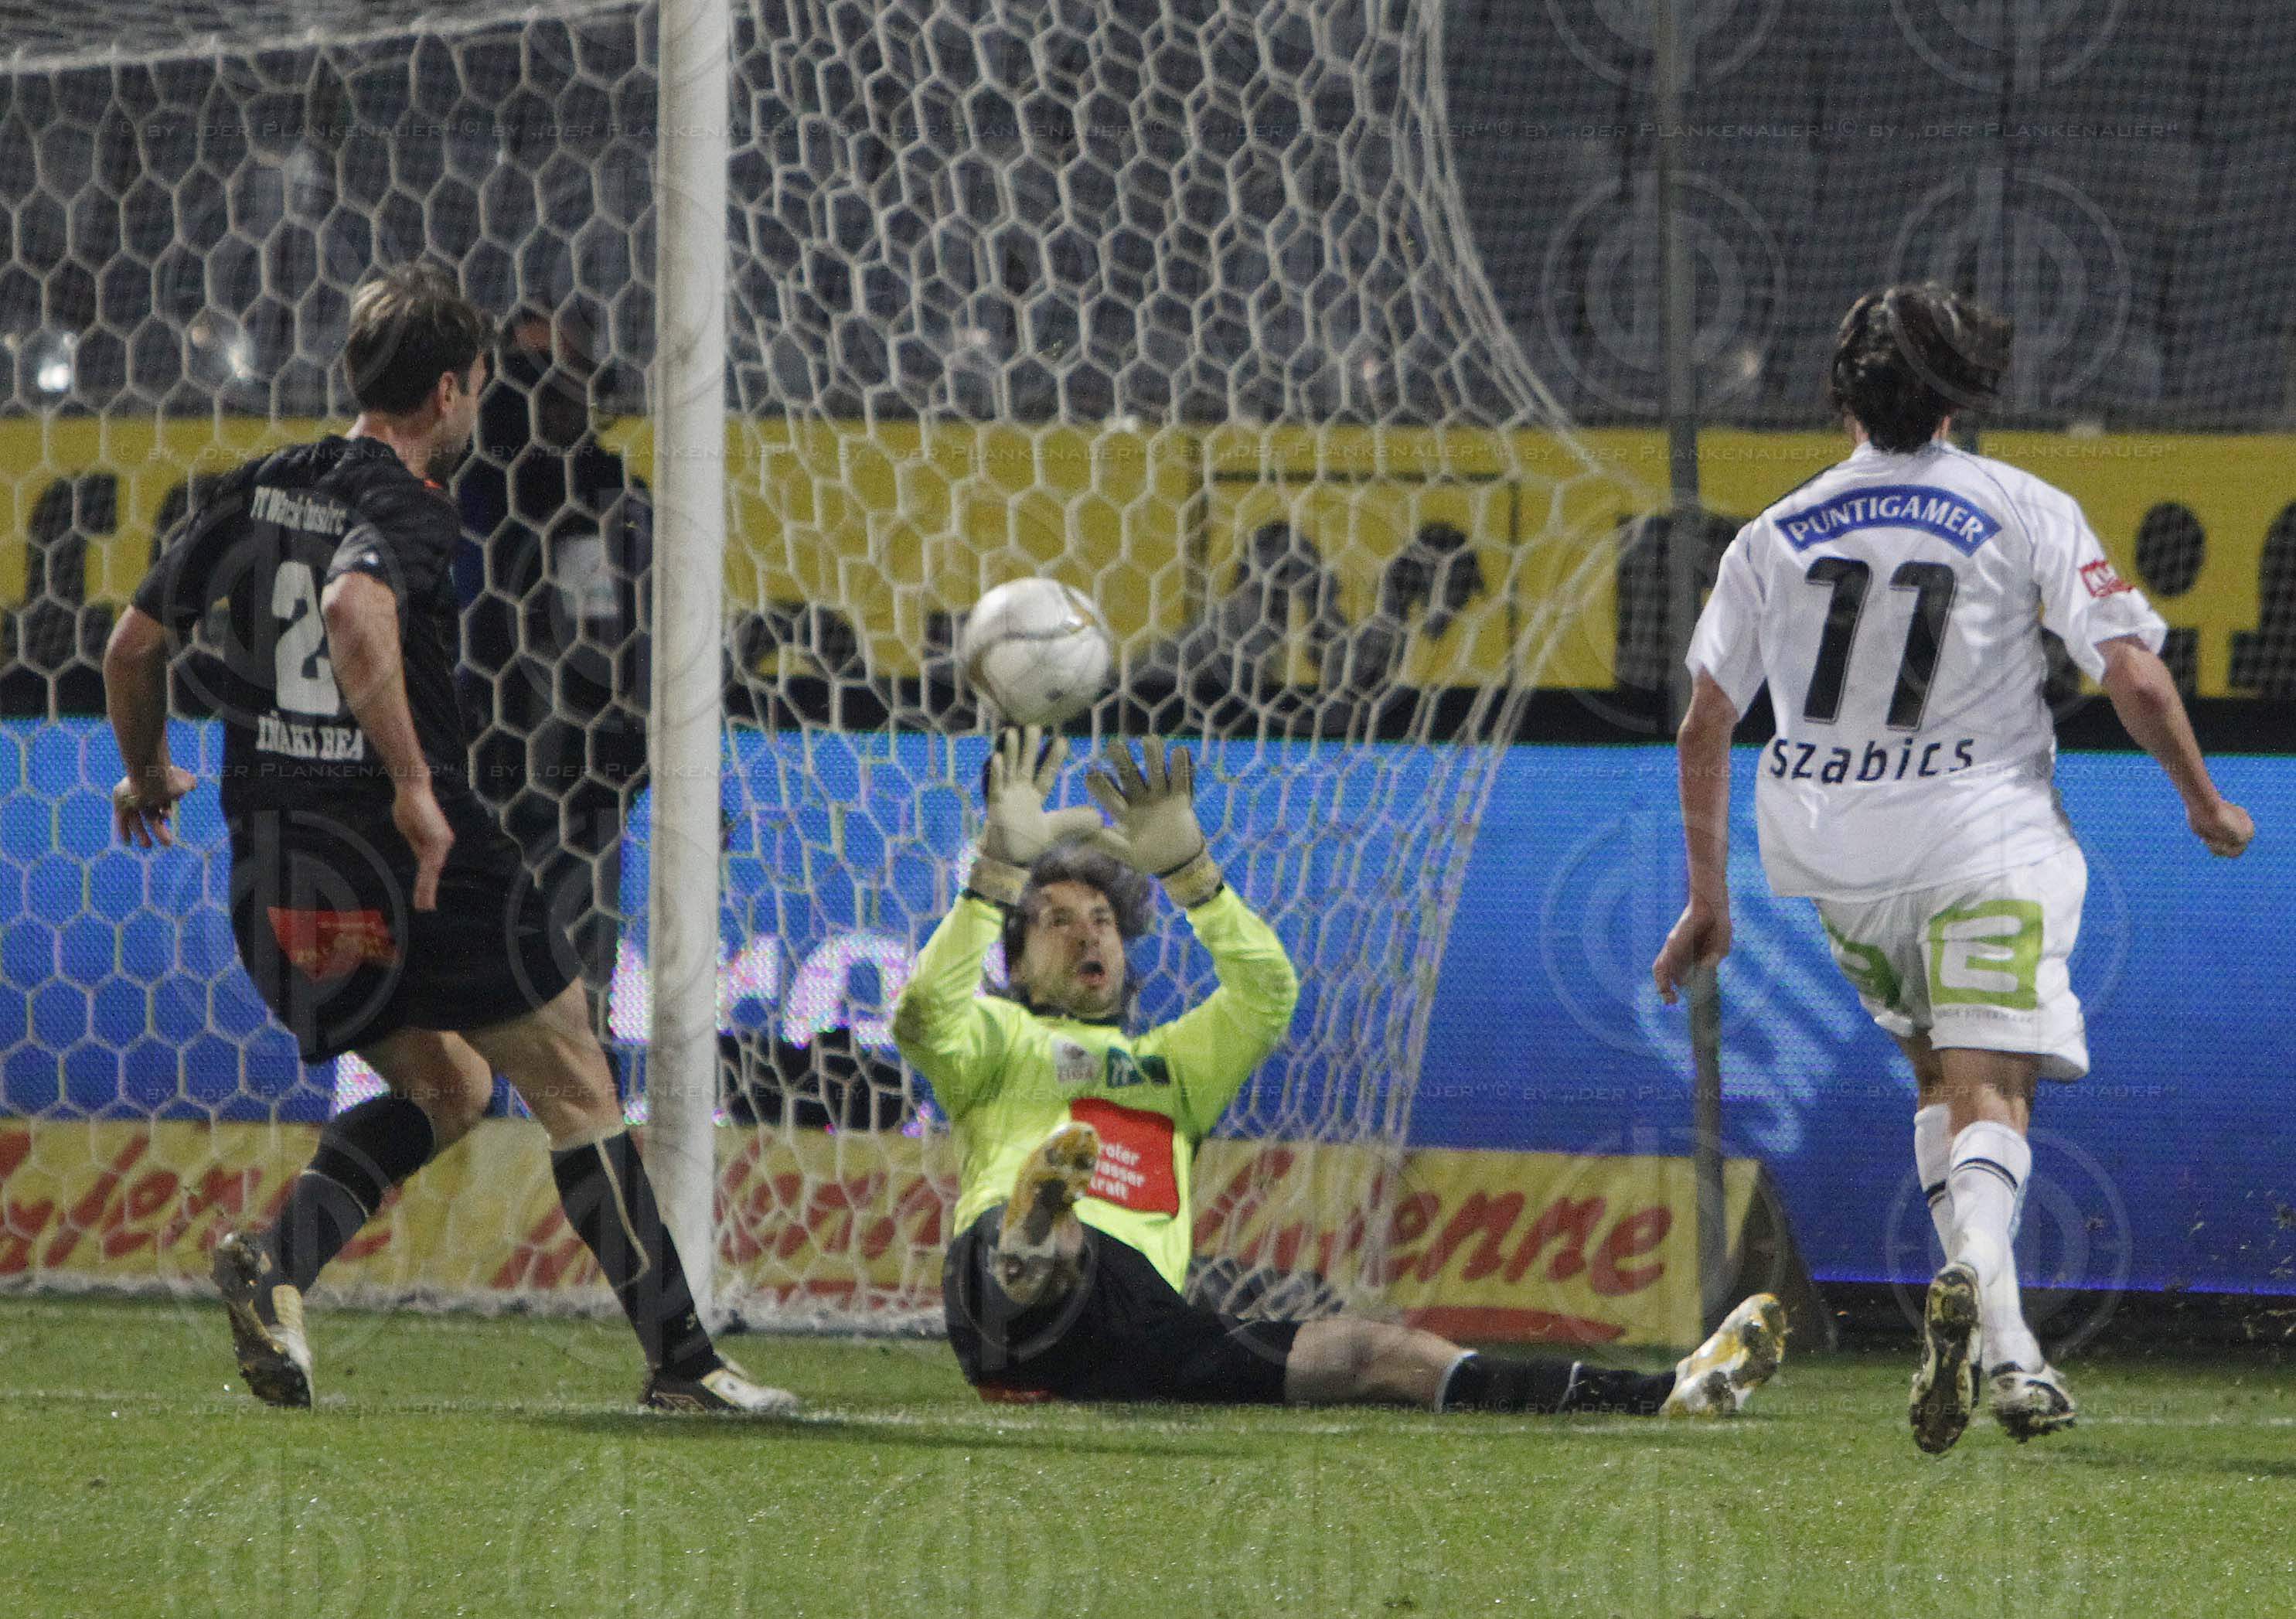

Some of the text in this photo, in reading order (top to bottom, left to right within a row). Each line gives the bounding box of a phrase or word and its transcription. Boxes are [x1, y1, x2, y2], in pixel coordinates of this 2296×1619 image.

[1786, 493, 1987, 543] PUNTIGAMER
[271, 559, 341, 716] 2
[1804, 557, 1957, 731] 11
